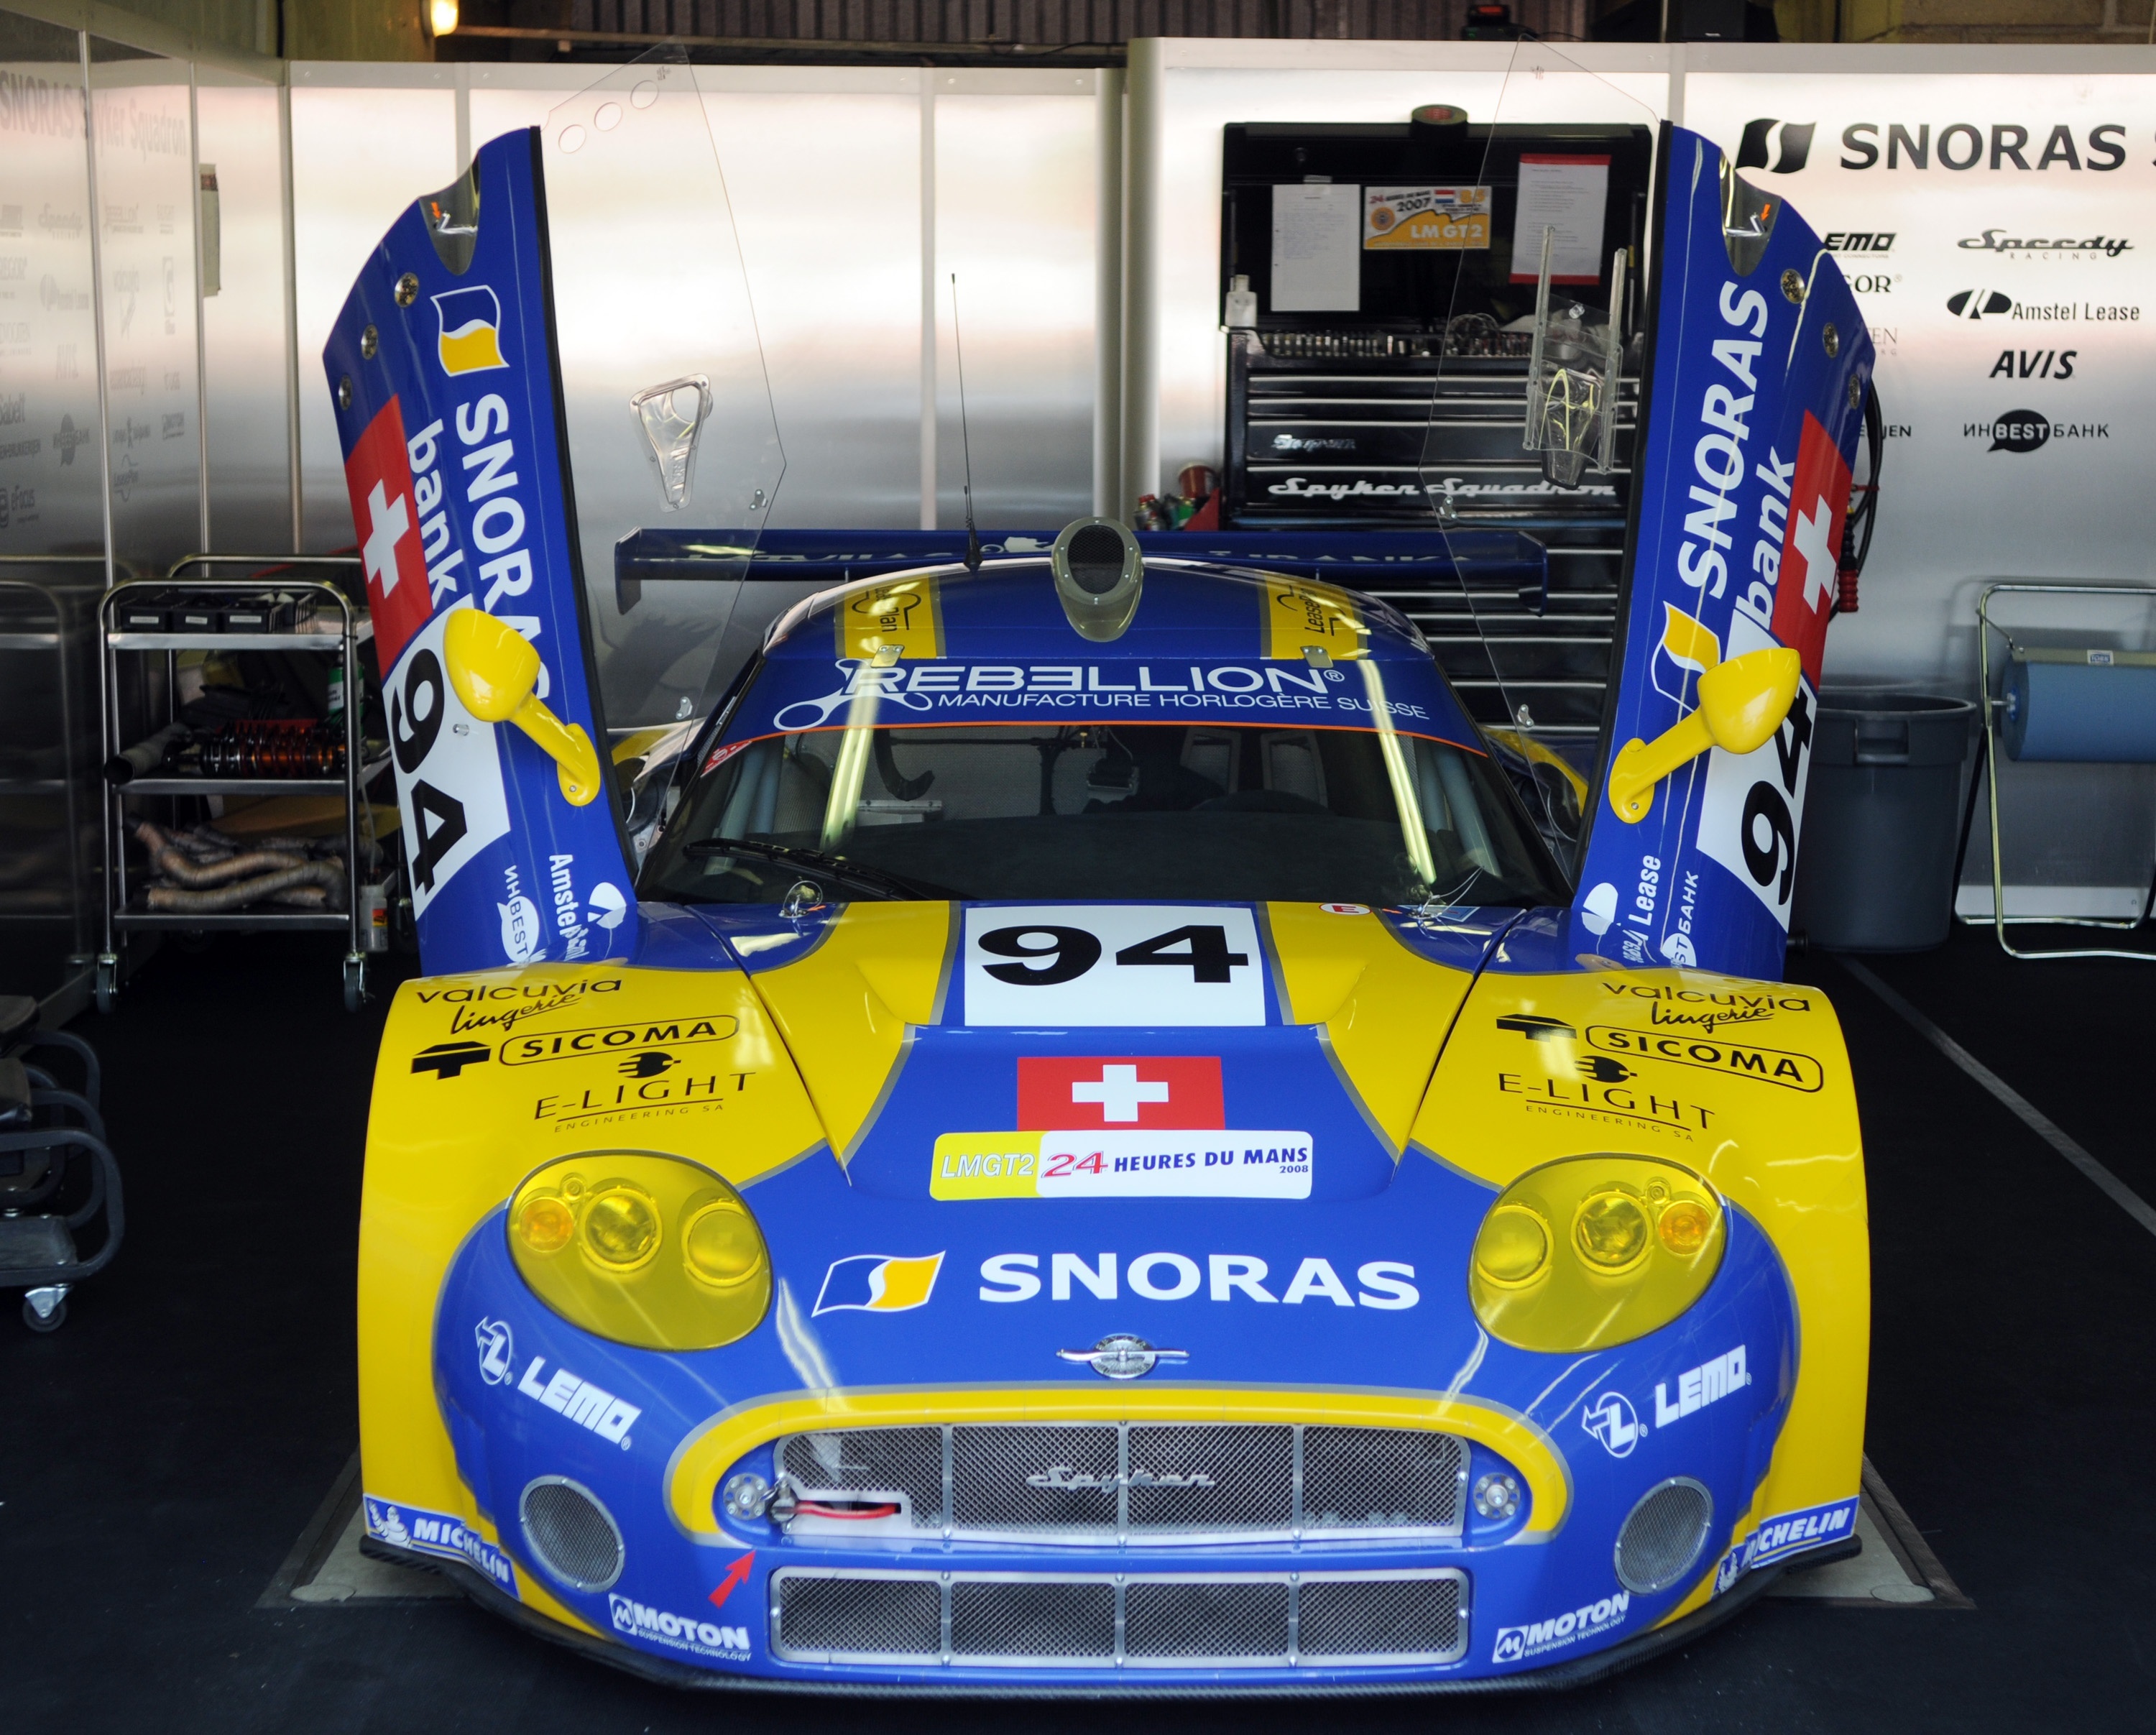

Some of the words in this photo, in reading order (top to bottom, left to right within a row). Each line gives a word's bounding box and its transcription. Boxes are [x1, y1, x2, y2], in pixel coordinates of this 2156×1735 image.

[1840, 124, 2127, 171] SNORAS
[1397, 198, 1430, 212] 2007
[1824, 232, 1897, 251] EMO
[1958, 229, 2134, 257] Speedy
[2012, 302, 2076, 320] Amstel
[2085, 302, 2140, 320] Lease
[1989, 350, 2077, 379] AVIS
[1678, 280, 1768, 599] SNORAS
[1268, 477, 1419, 500] Spyker
[407, 418, 464, 610] bank
[455, 393, 550, 699] SNOR
[1736, 446, 1795, 631] bank
[937, 694, 1151, 707] MANUFACTURE
[1159, 692, 1332, 709] HORLOGÈRE
[1338, 697, 1430, 719] SUISSE
[391, 648, 468, 896] 94
[1741, 686, 1813, 906] 94
[1332, 904, 1360, 913] E
[1628, 855, 1662, 926] Lease
[978, 924, 1249, 986] 94
[415, 977, 623, 1004] valcuvia
[1602, 982, 1811, 1012] valcuvia
[520, 1021, 718, 1058] SICOMA
[1608, 1031, 1805, 1083] SICOMA
[534, 1072, 756, 1120] E-LIGHT
[1498, 1072, 1716, 1130] E-LIGHT
[553, 1106, 691, 1133] ENGINEERING
[702, 1104, 724, 1113] SA
[1526, 1105, 1662, 1133] ENGINEERING
[1673, 1130, 1694, 1143] SA
[939, 1153, 1036, 1179] LMGT2
[1041, 1151, 1109, 1179] 24
[1114, 1153, 1196, 1173] HEURES
[1204, 1150, 1234, 1167] DU
[1243, 1147, 1308, 1164] MANS
[1279, 1164, 1309, 1174] 2008
[979, 1251, 1421, 1310] SNORAS
[413, 1517, 510, 1583] MICHELIN
[632, 1602, 750, 1650] MOTON
[1526, 1590, 1630, 1647] MOTON
[1524, 1635, 1576, 1657] SUSPENSION
